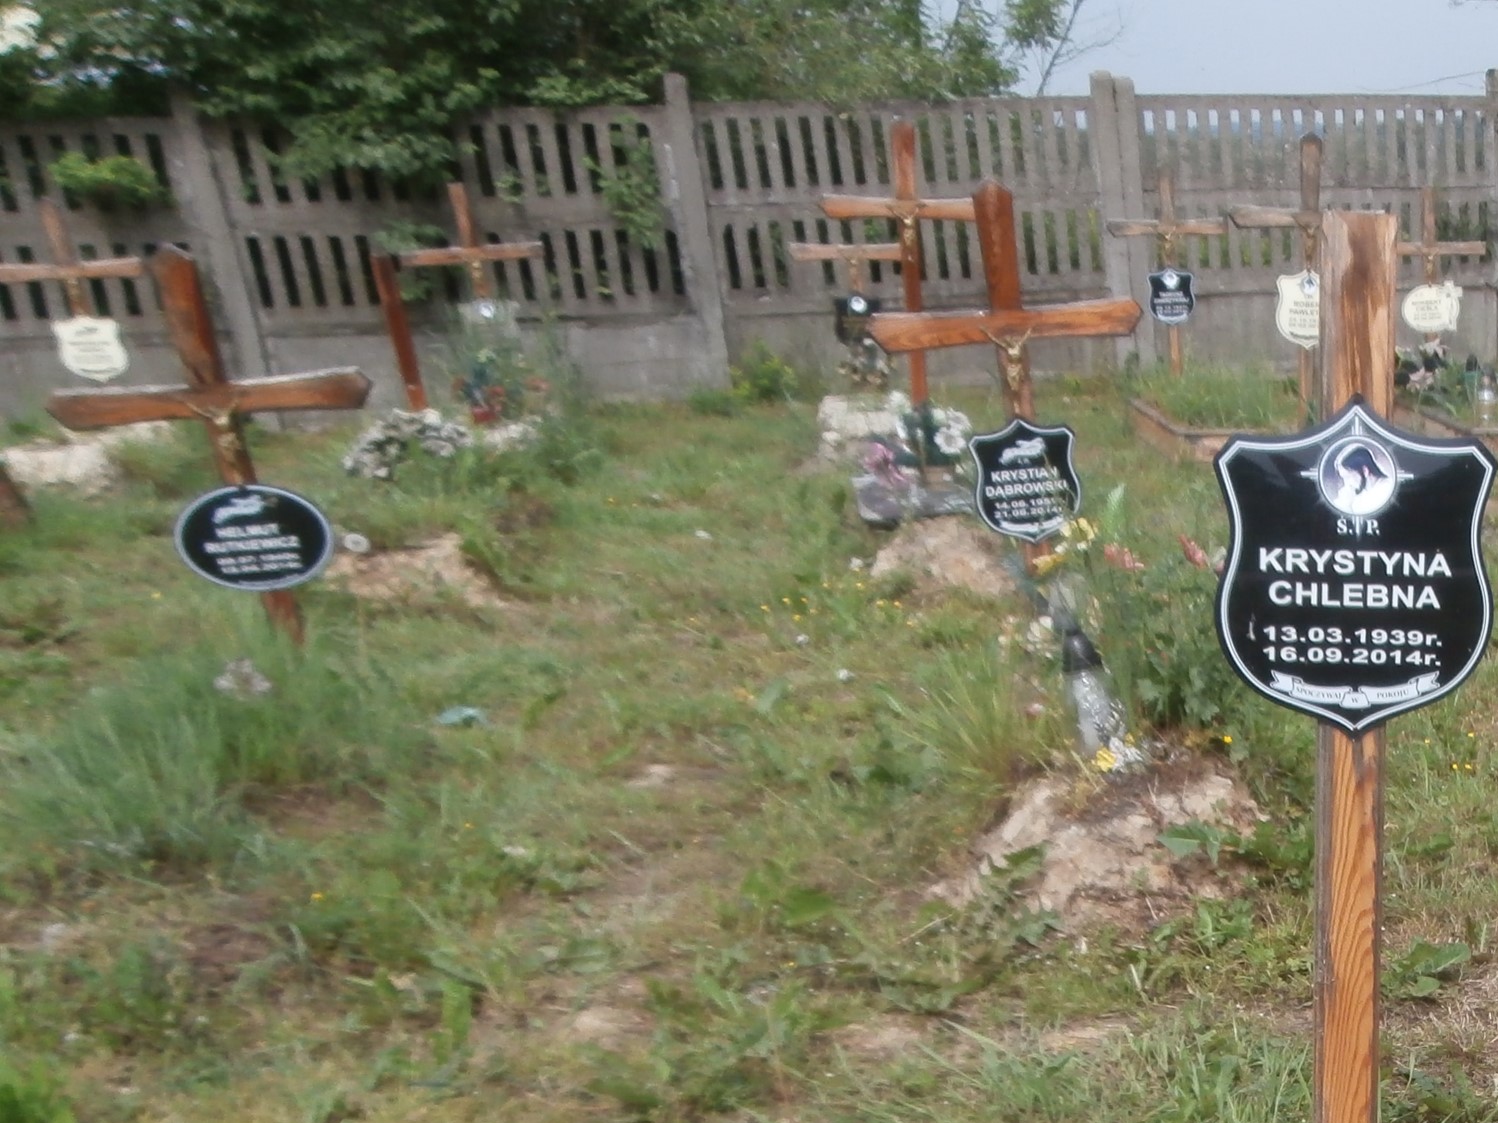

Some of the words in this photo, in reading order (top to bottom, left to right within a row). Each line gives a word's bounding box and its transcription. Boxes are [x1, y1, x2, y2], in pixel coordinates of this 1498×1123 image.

[1259, 547, 1452, 577] KRYSTYNA
[1268, 580, 1441, 610] CHLEBNA
[1263, 625, 1442, 647] 13.03.1939r.
[1262, 646, 1441, 667] 16.09.2014r.
